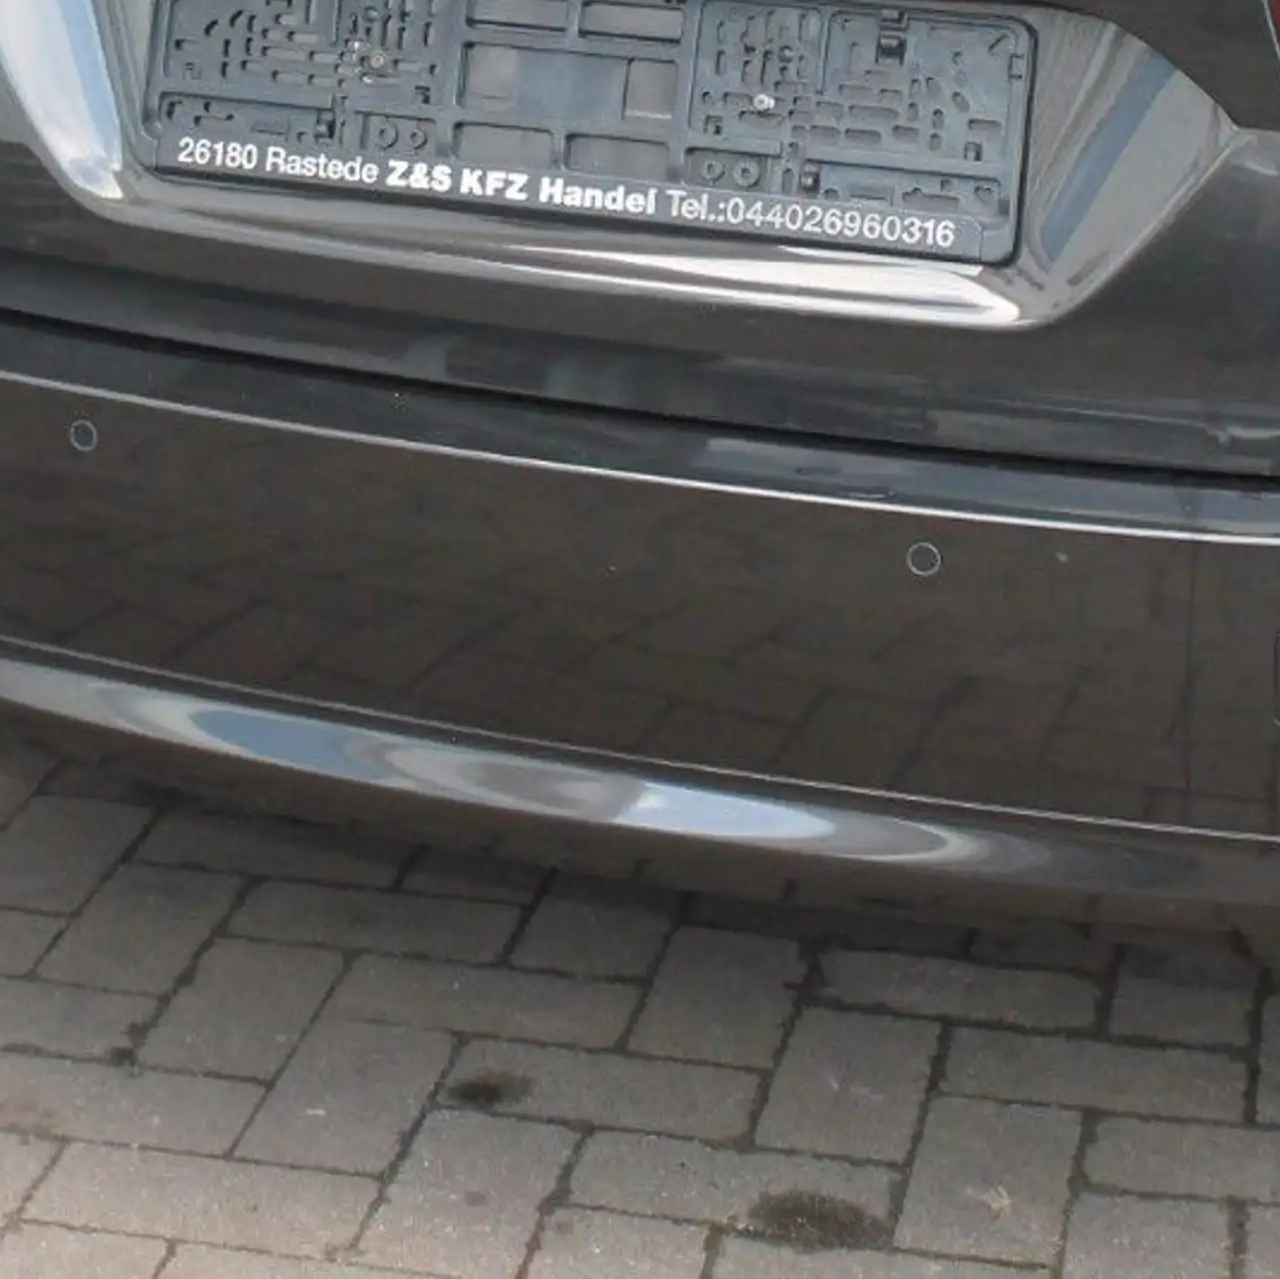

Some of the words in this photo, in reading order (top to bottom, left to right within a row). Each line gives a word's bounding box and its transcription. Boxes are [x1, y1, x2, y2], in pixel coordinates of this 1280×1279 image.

[177, 136, 258, 170] 26180
[265, 146, 380, 184] Rastede
[385, 158, 452, 192] Z&S
[460, 167, 529, 201] KFZ
[538, 176, 658, 215] Handel
